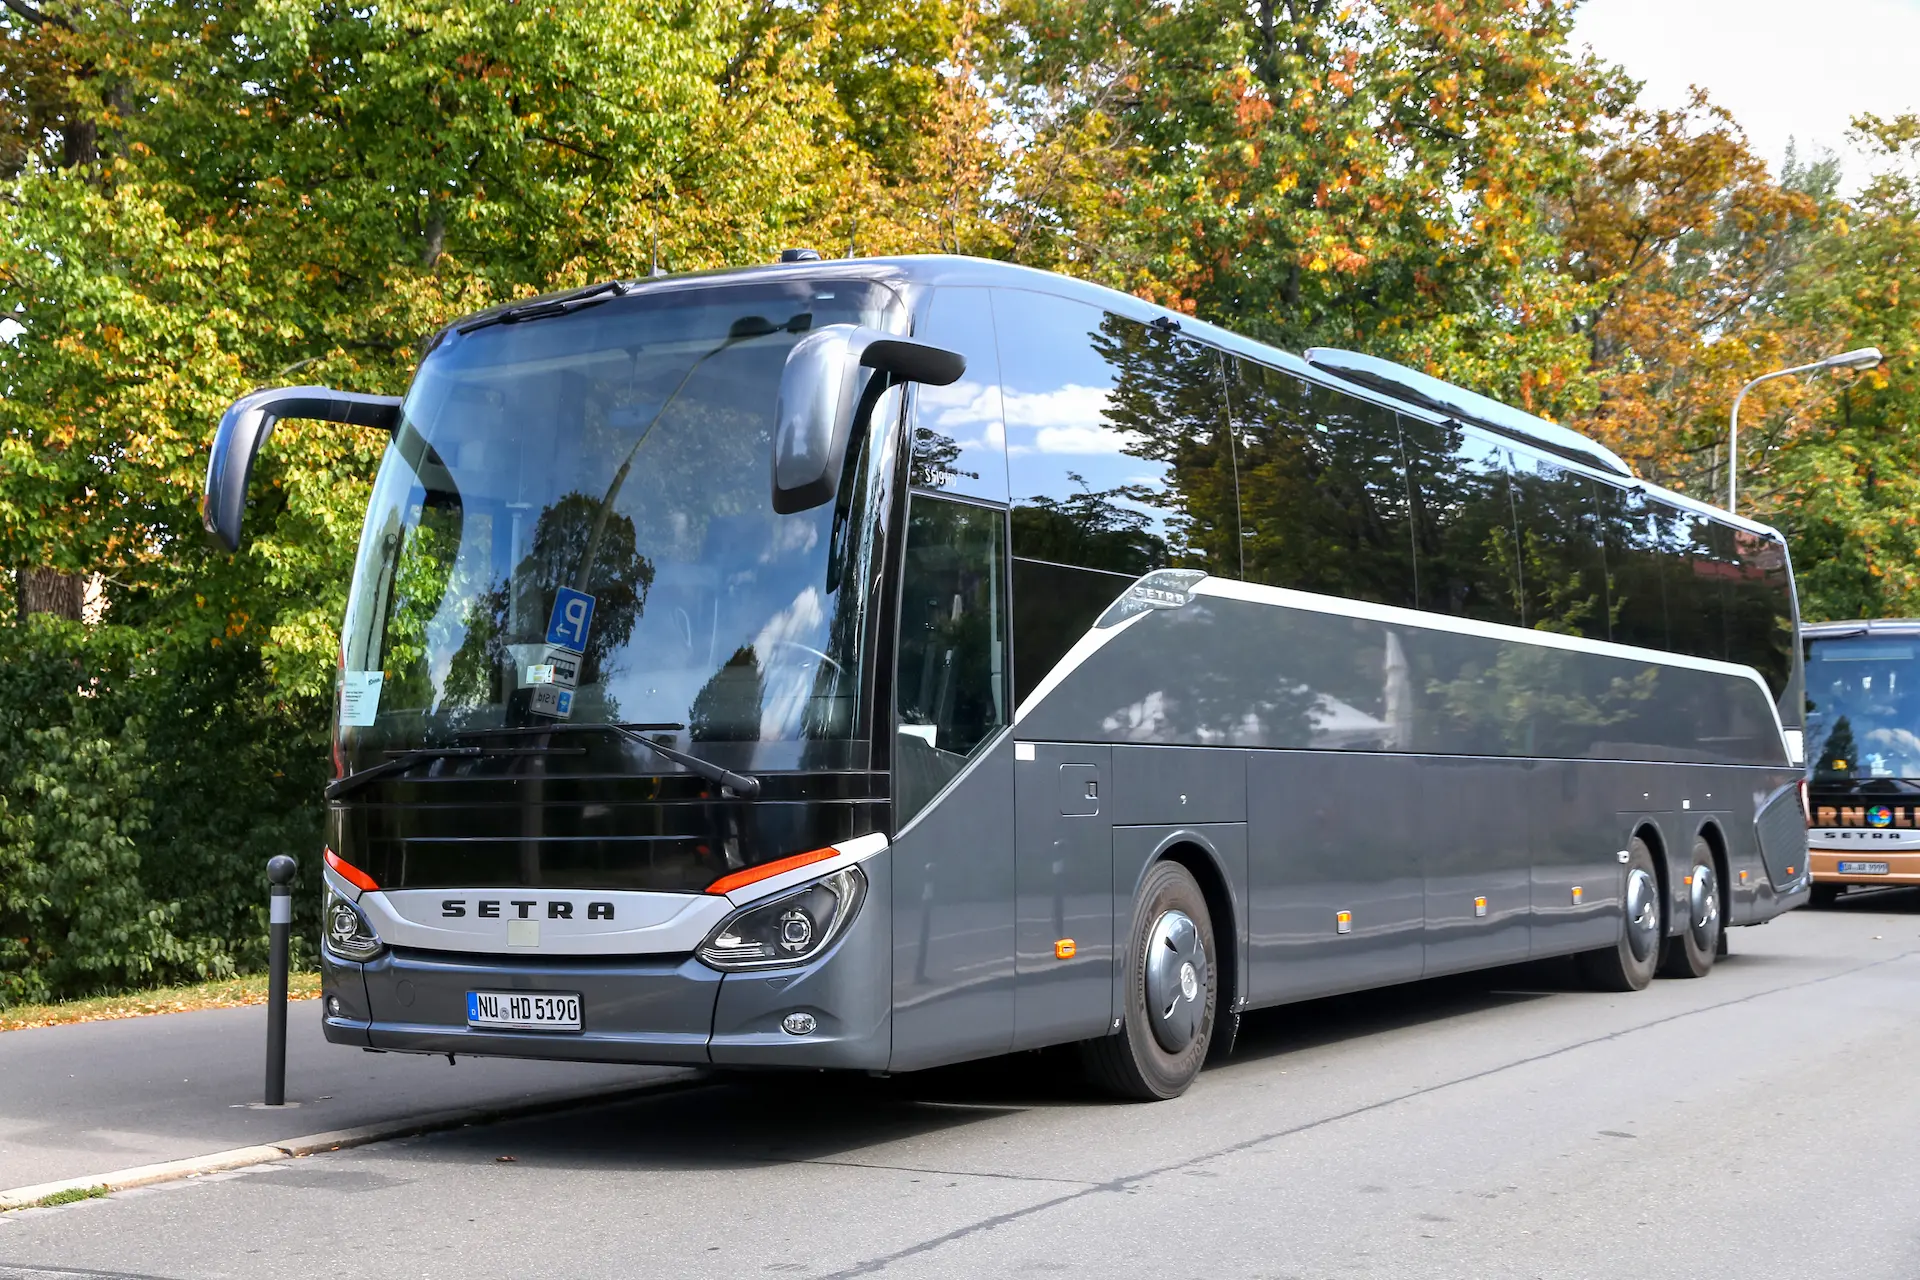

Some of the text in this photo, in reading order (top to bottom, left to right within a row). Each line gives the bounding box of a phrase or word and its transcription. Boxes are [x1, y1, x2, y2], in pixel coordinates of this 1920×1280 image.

[1134, 587, 1185, 604] SETRA
[441, 900, 615, 920] SETRA
[478, 995, 577, 1021] NU HD 5190
